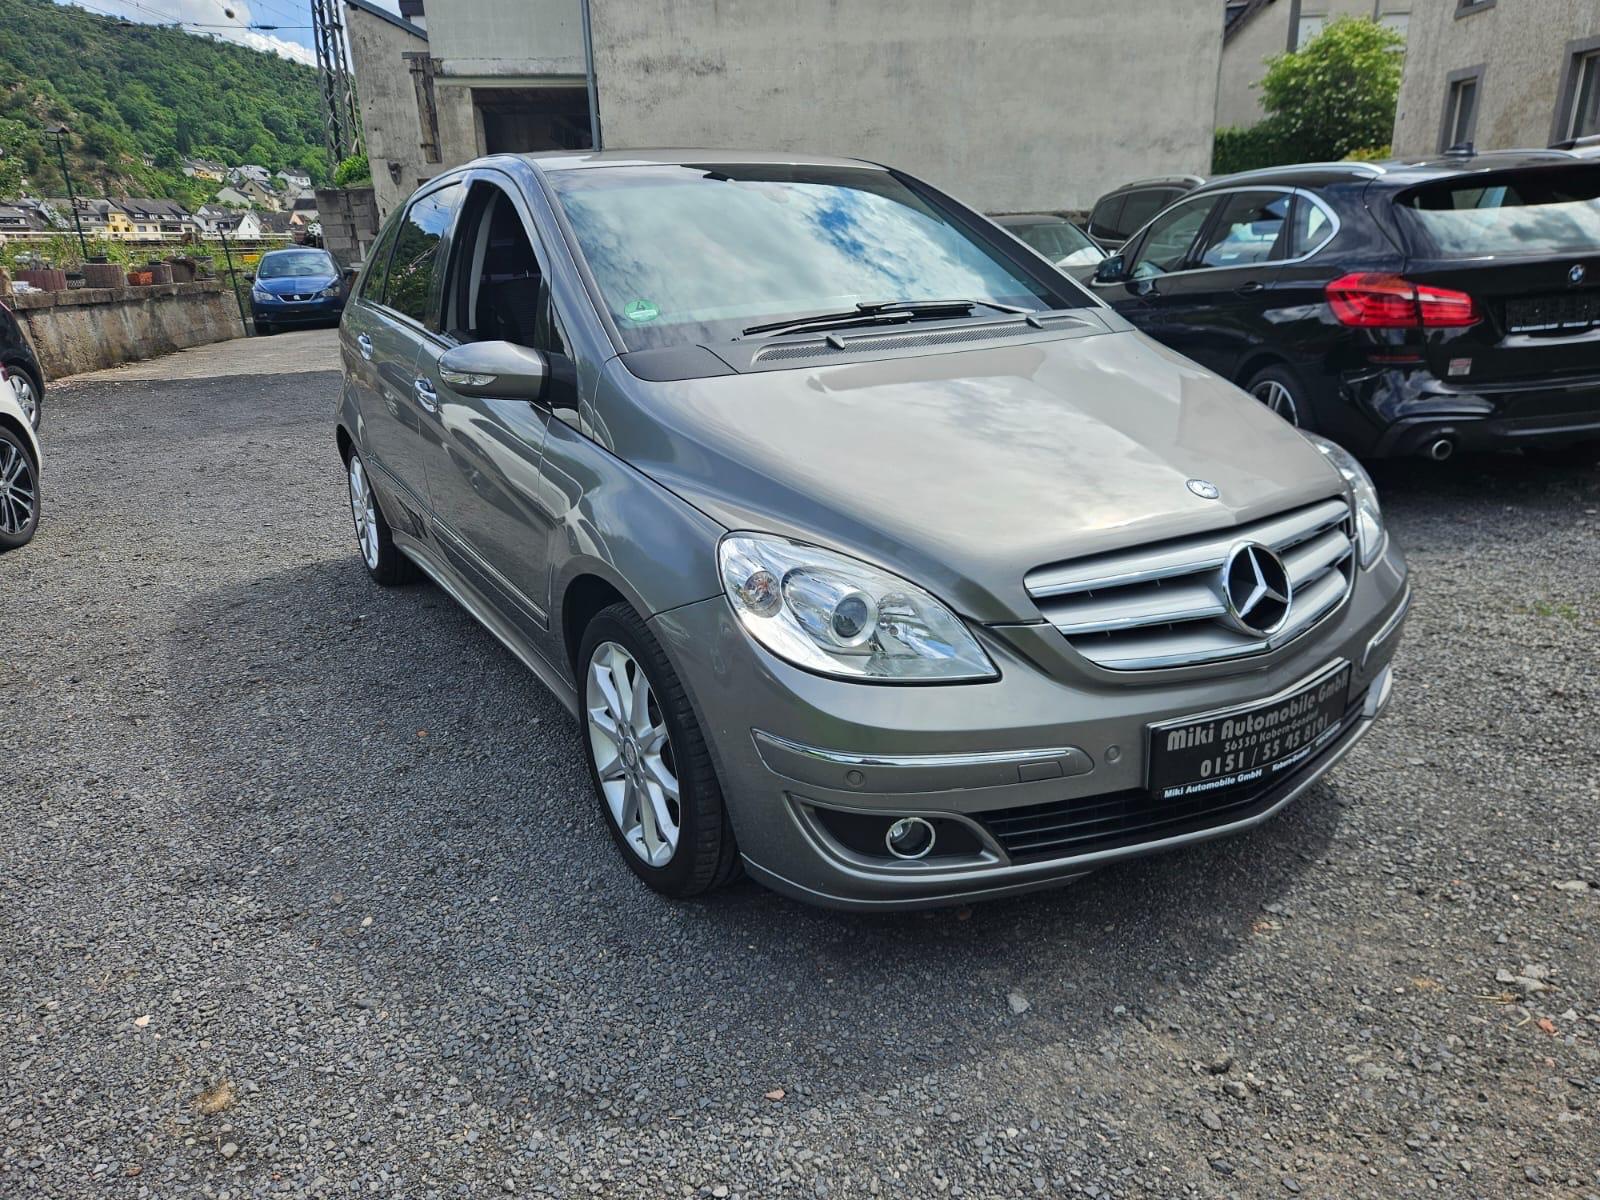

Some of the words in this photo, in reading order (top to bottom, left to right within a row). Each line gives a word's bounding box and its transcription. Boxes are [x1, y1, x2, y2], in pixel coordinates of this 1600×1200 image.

[1167, 723, 1215, 751] Miki
[1221, 693, 1316, 740] Automobile
[1319, 668, 1349, 703] GmbH
[1200, 751, 1244, 777] 0151
[1251, 747, 1258, 767] /
[1262, 739, 1280, 760] 55
[1285, 730, 1300, 750] 45
[1224, 734, 1257, 753] 56330
[1164, 787, 1184, 798] Miki
[1185, 776, 1236, 794] Automobile
[1237, 768, 1263, 783] GmbH
